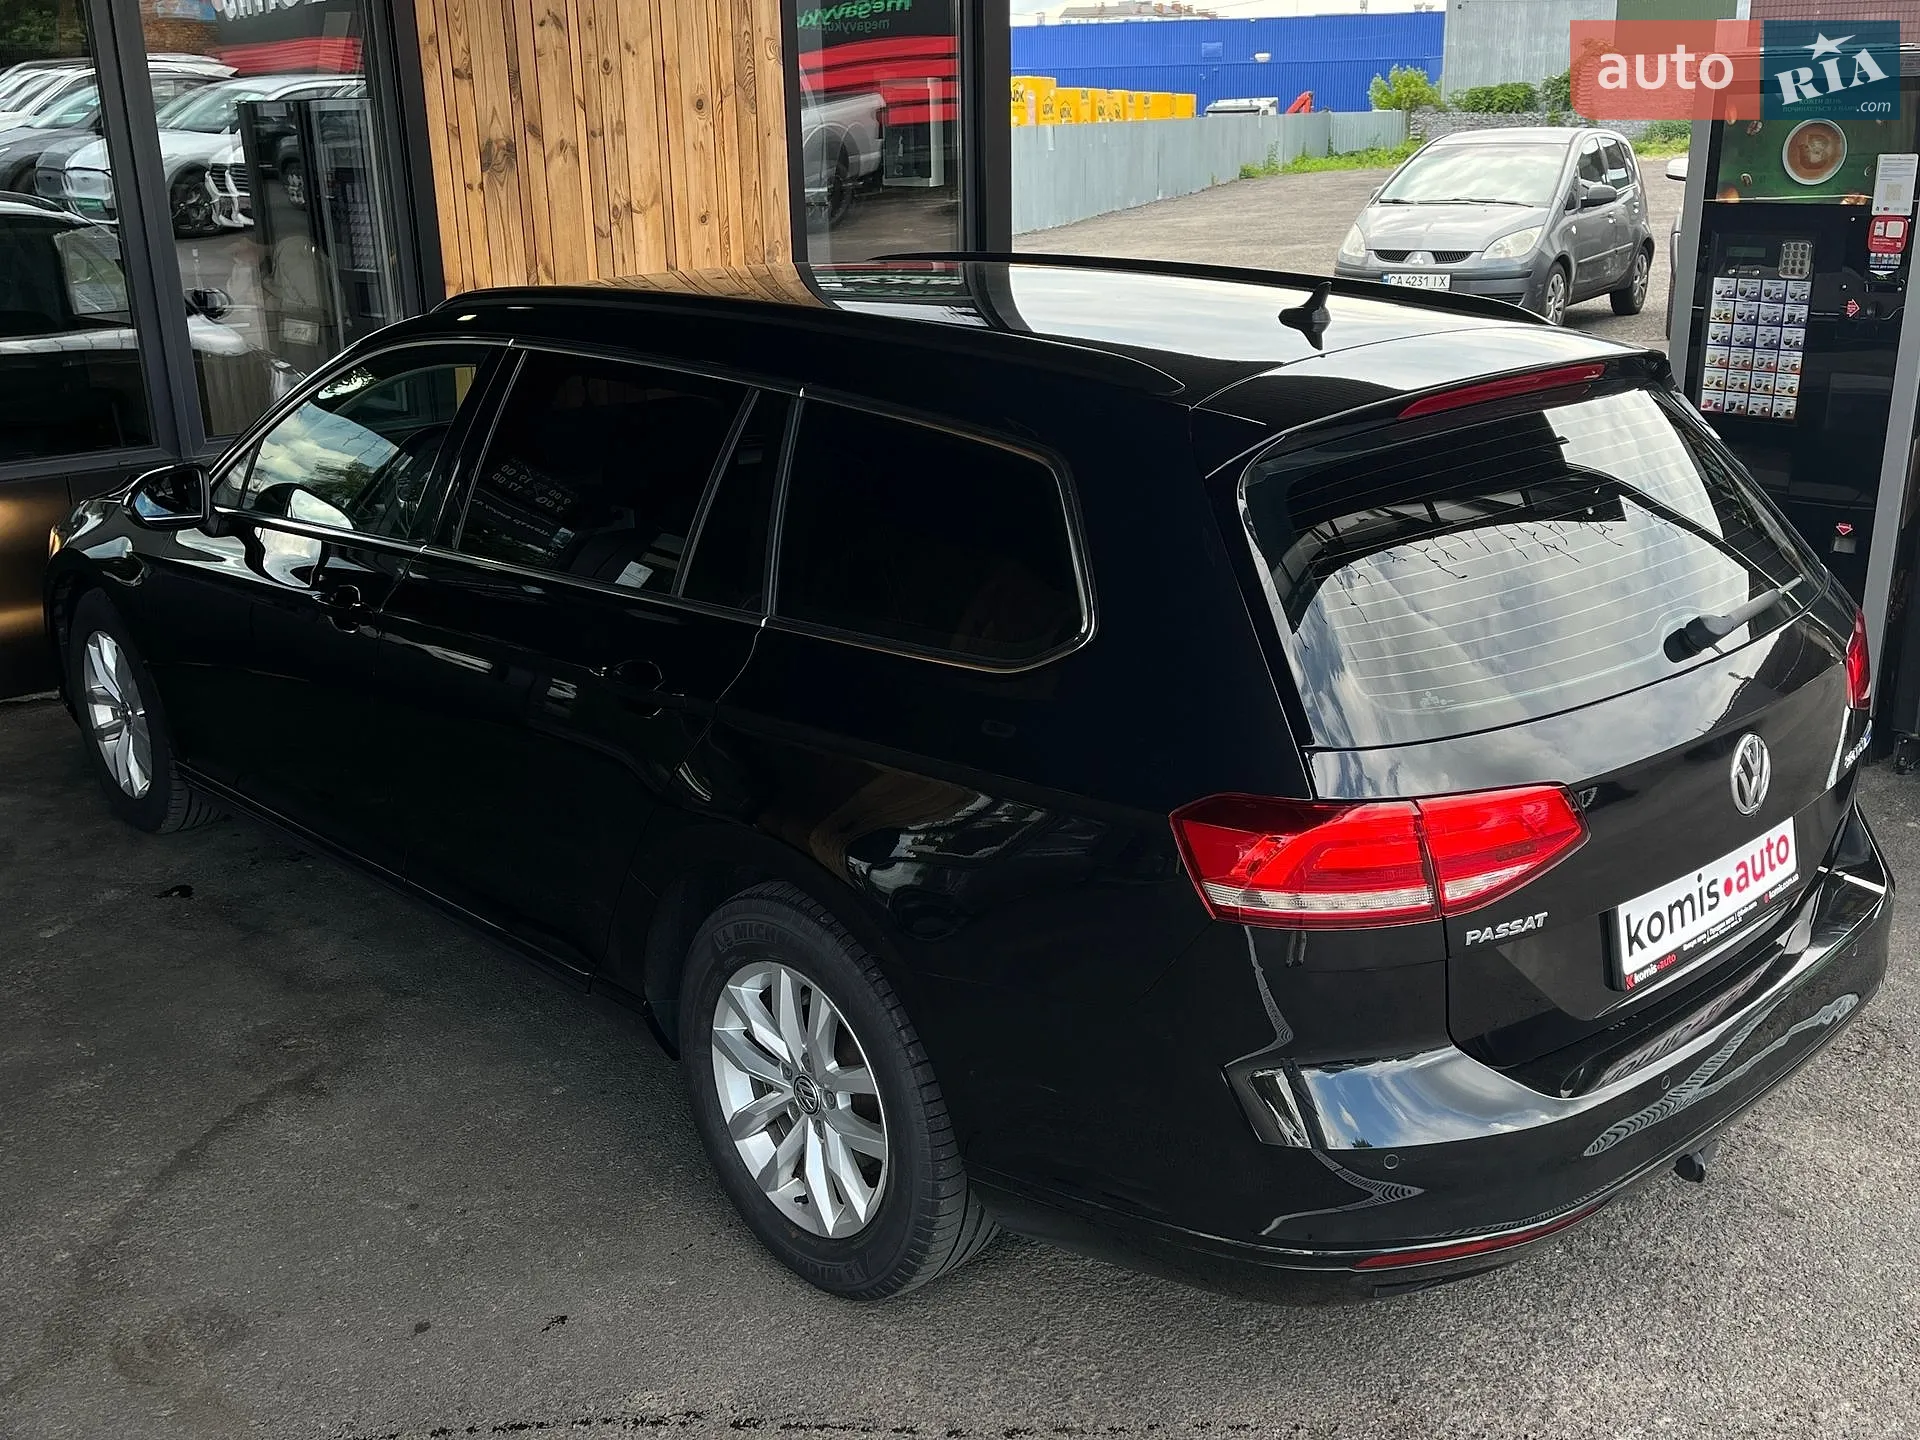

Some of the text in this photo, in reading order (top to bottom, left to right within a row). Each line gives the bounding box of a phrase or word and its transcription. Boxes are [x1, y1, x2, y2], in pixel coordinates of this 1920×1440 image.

[1389, 275, 1447, 288] CA 4231 IX
[1465, 911, 1549, 946] PASSAT
